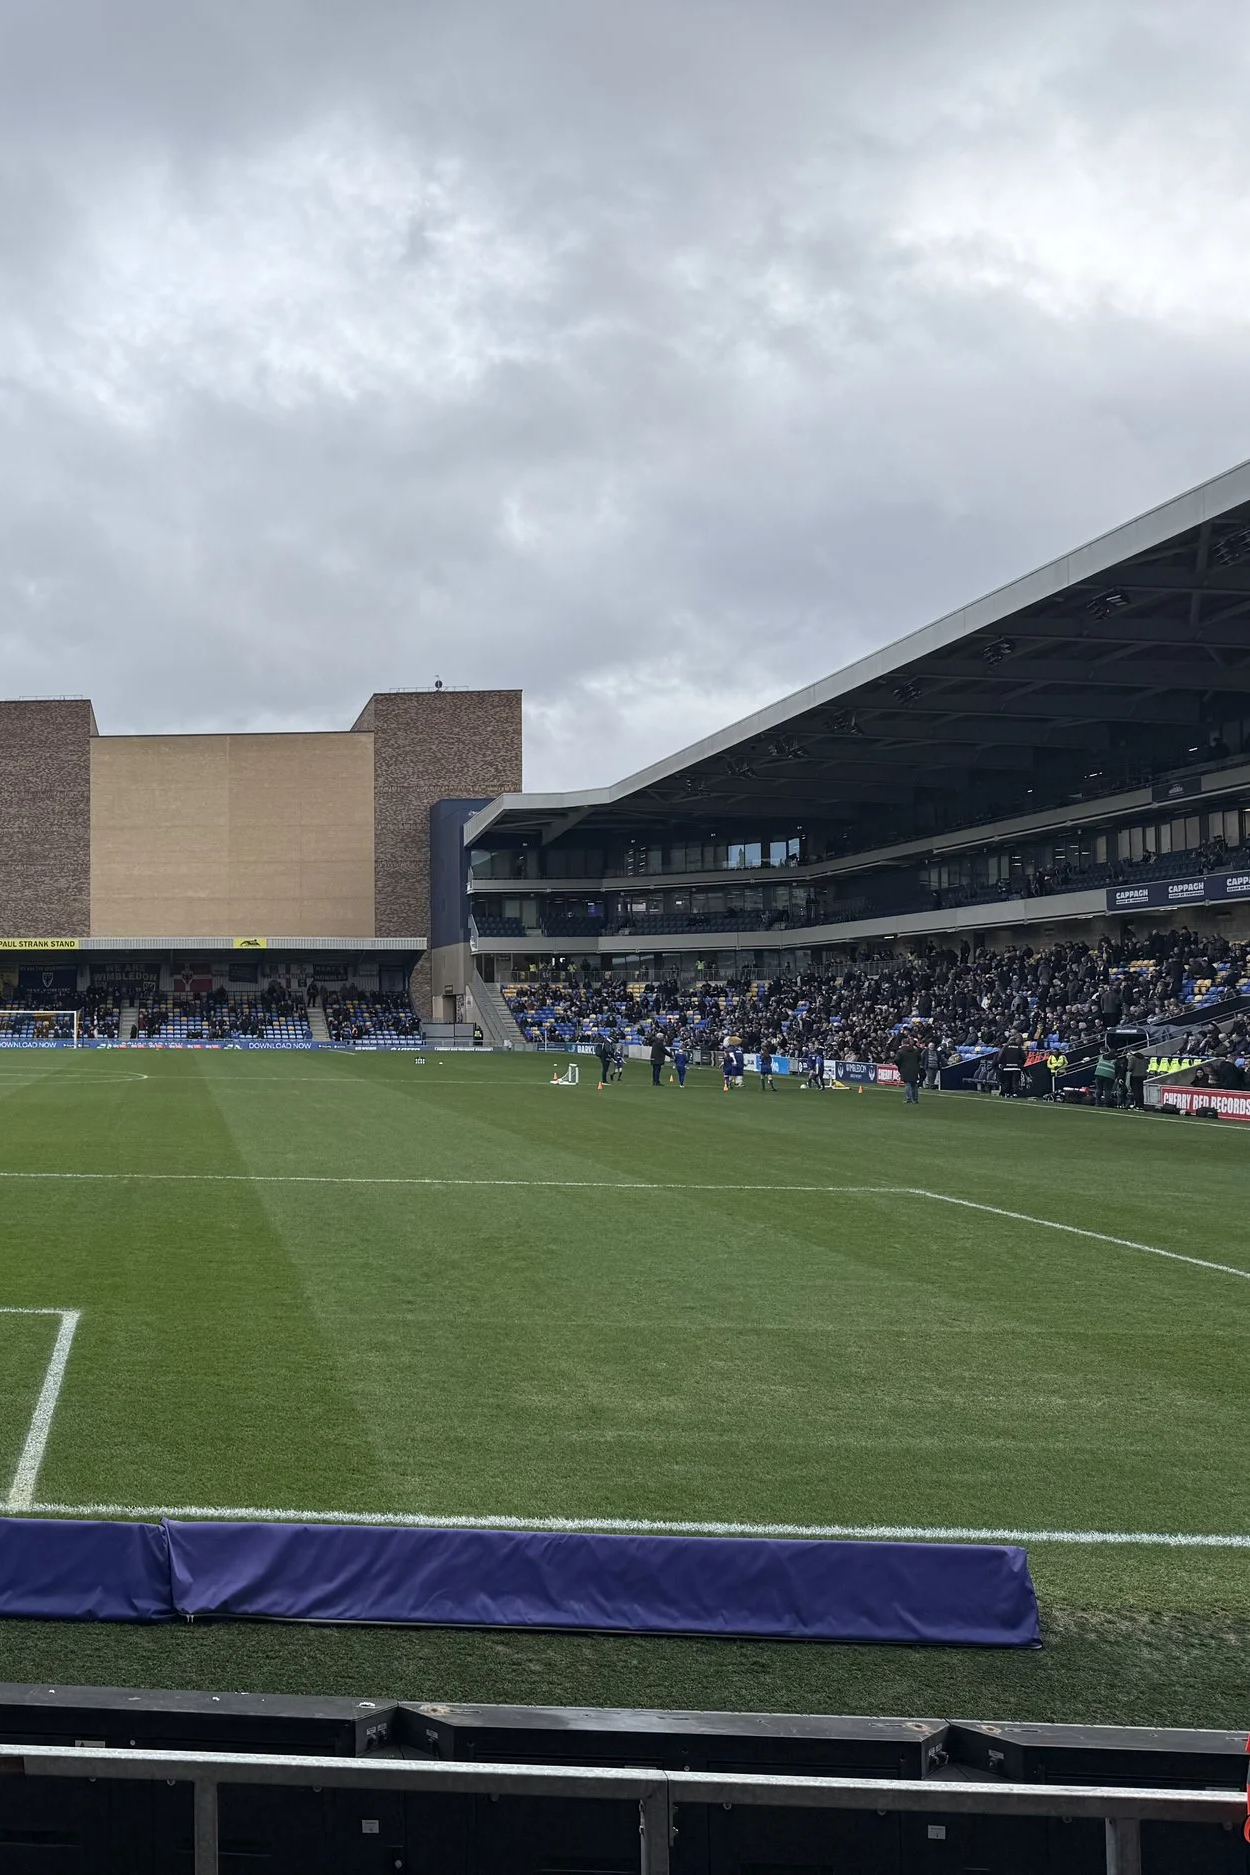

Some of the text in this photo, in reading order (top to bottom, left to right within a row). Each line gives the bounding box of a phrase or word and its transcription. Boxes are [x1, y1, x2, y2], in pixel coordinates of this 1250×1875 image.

[1226, 876, 1250, 887] CAPP
[1168, 882, 1204, 893] CAPPAGH
[1116, 889, 1149, 900] CAPPAGH
[19, 940, 49, 948] STRANK
[50, 940, 75, 948] STAND
[93, 972, 157, 981] WIMBLEDON
[1163, 1092, 1250, 1116] CHERRY RED RECORDS
